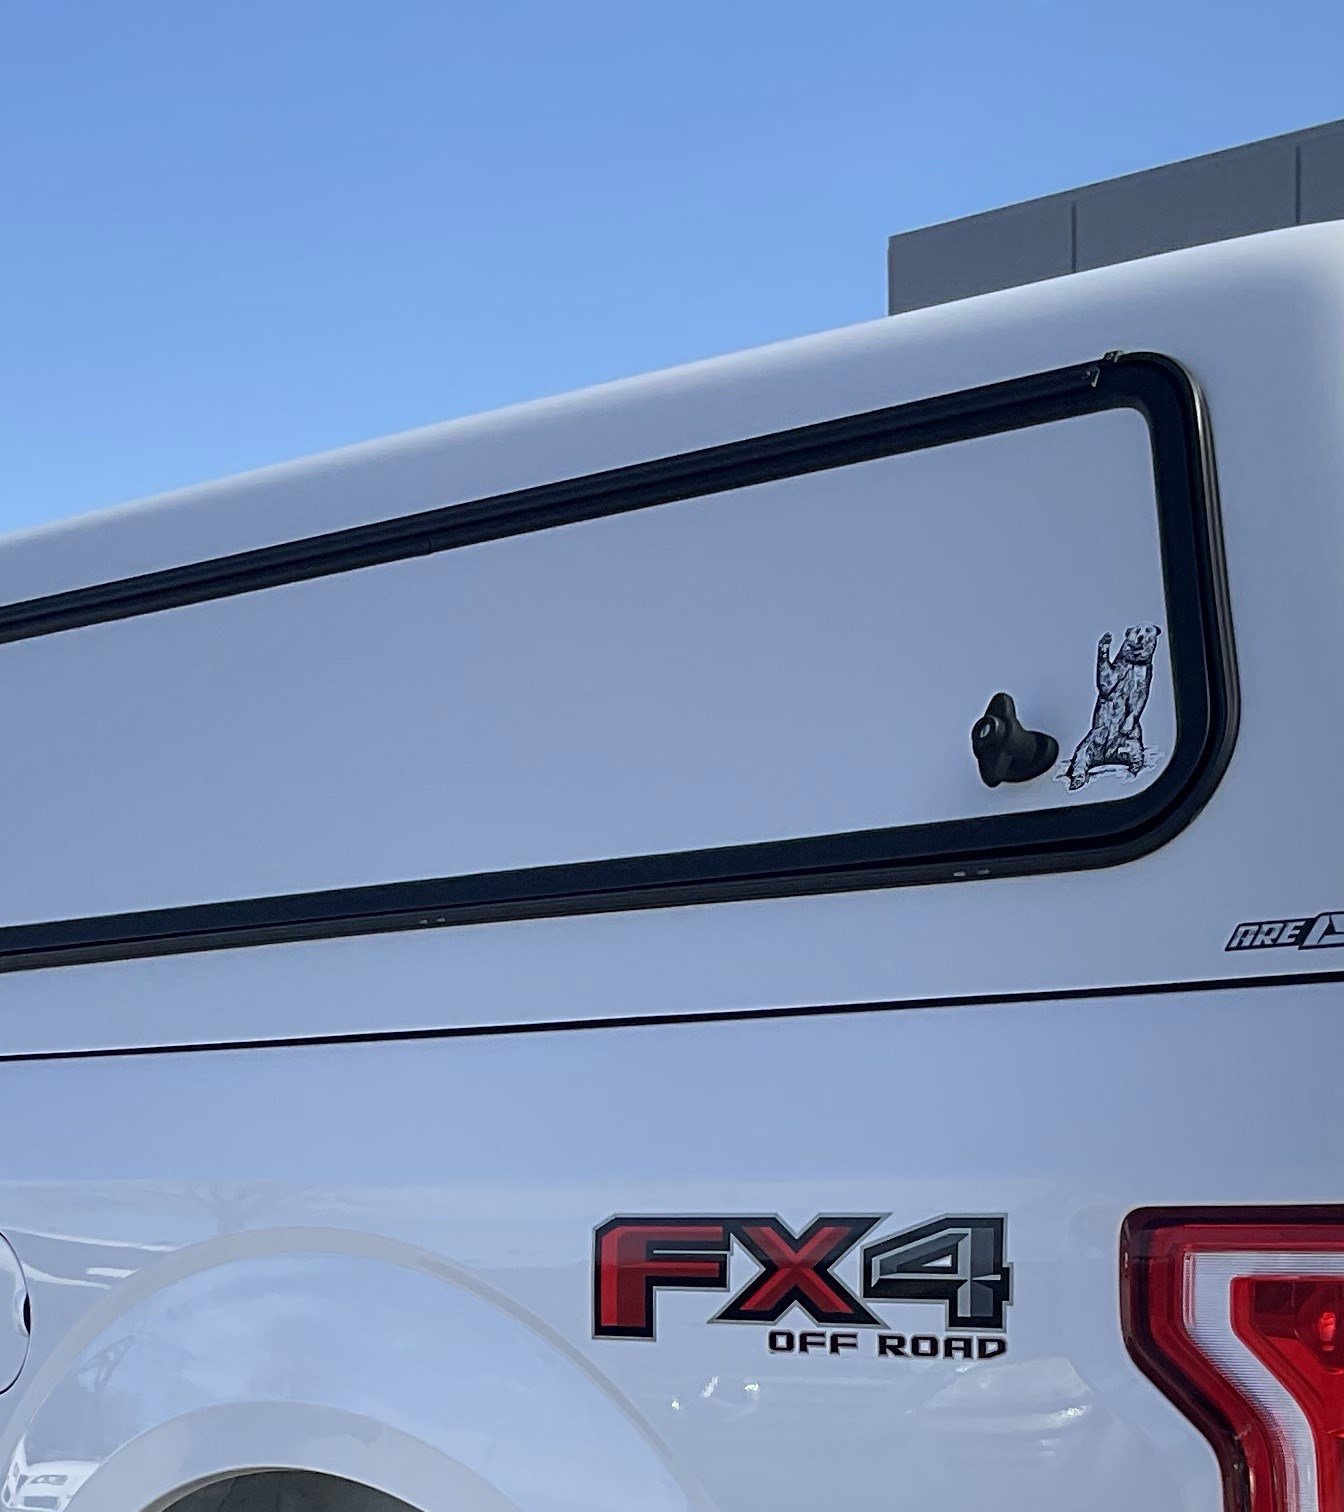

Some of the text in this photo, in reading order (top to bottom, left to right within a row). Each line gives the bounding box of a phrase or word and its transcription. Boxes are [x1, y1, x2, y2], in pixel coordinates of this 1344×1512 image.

[592, 1213, 1015, 1342] FX4
[767, 1330, 1008, 1360] OFF ROAD
